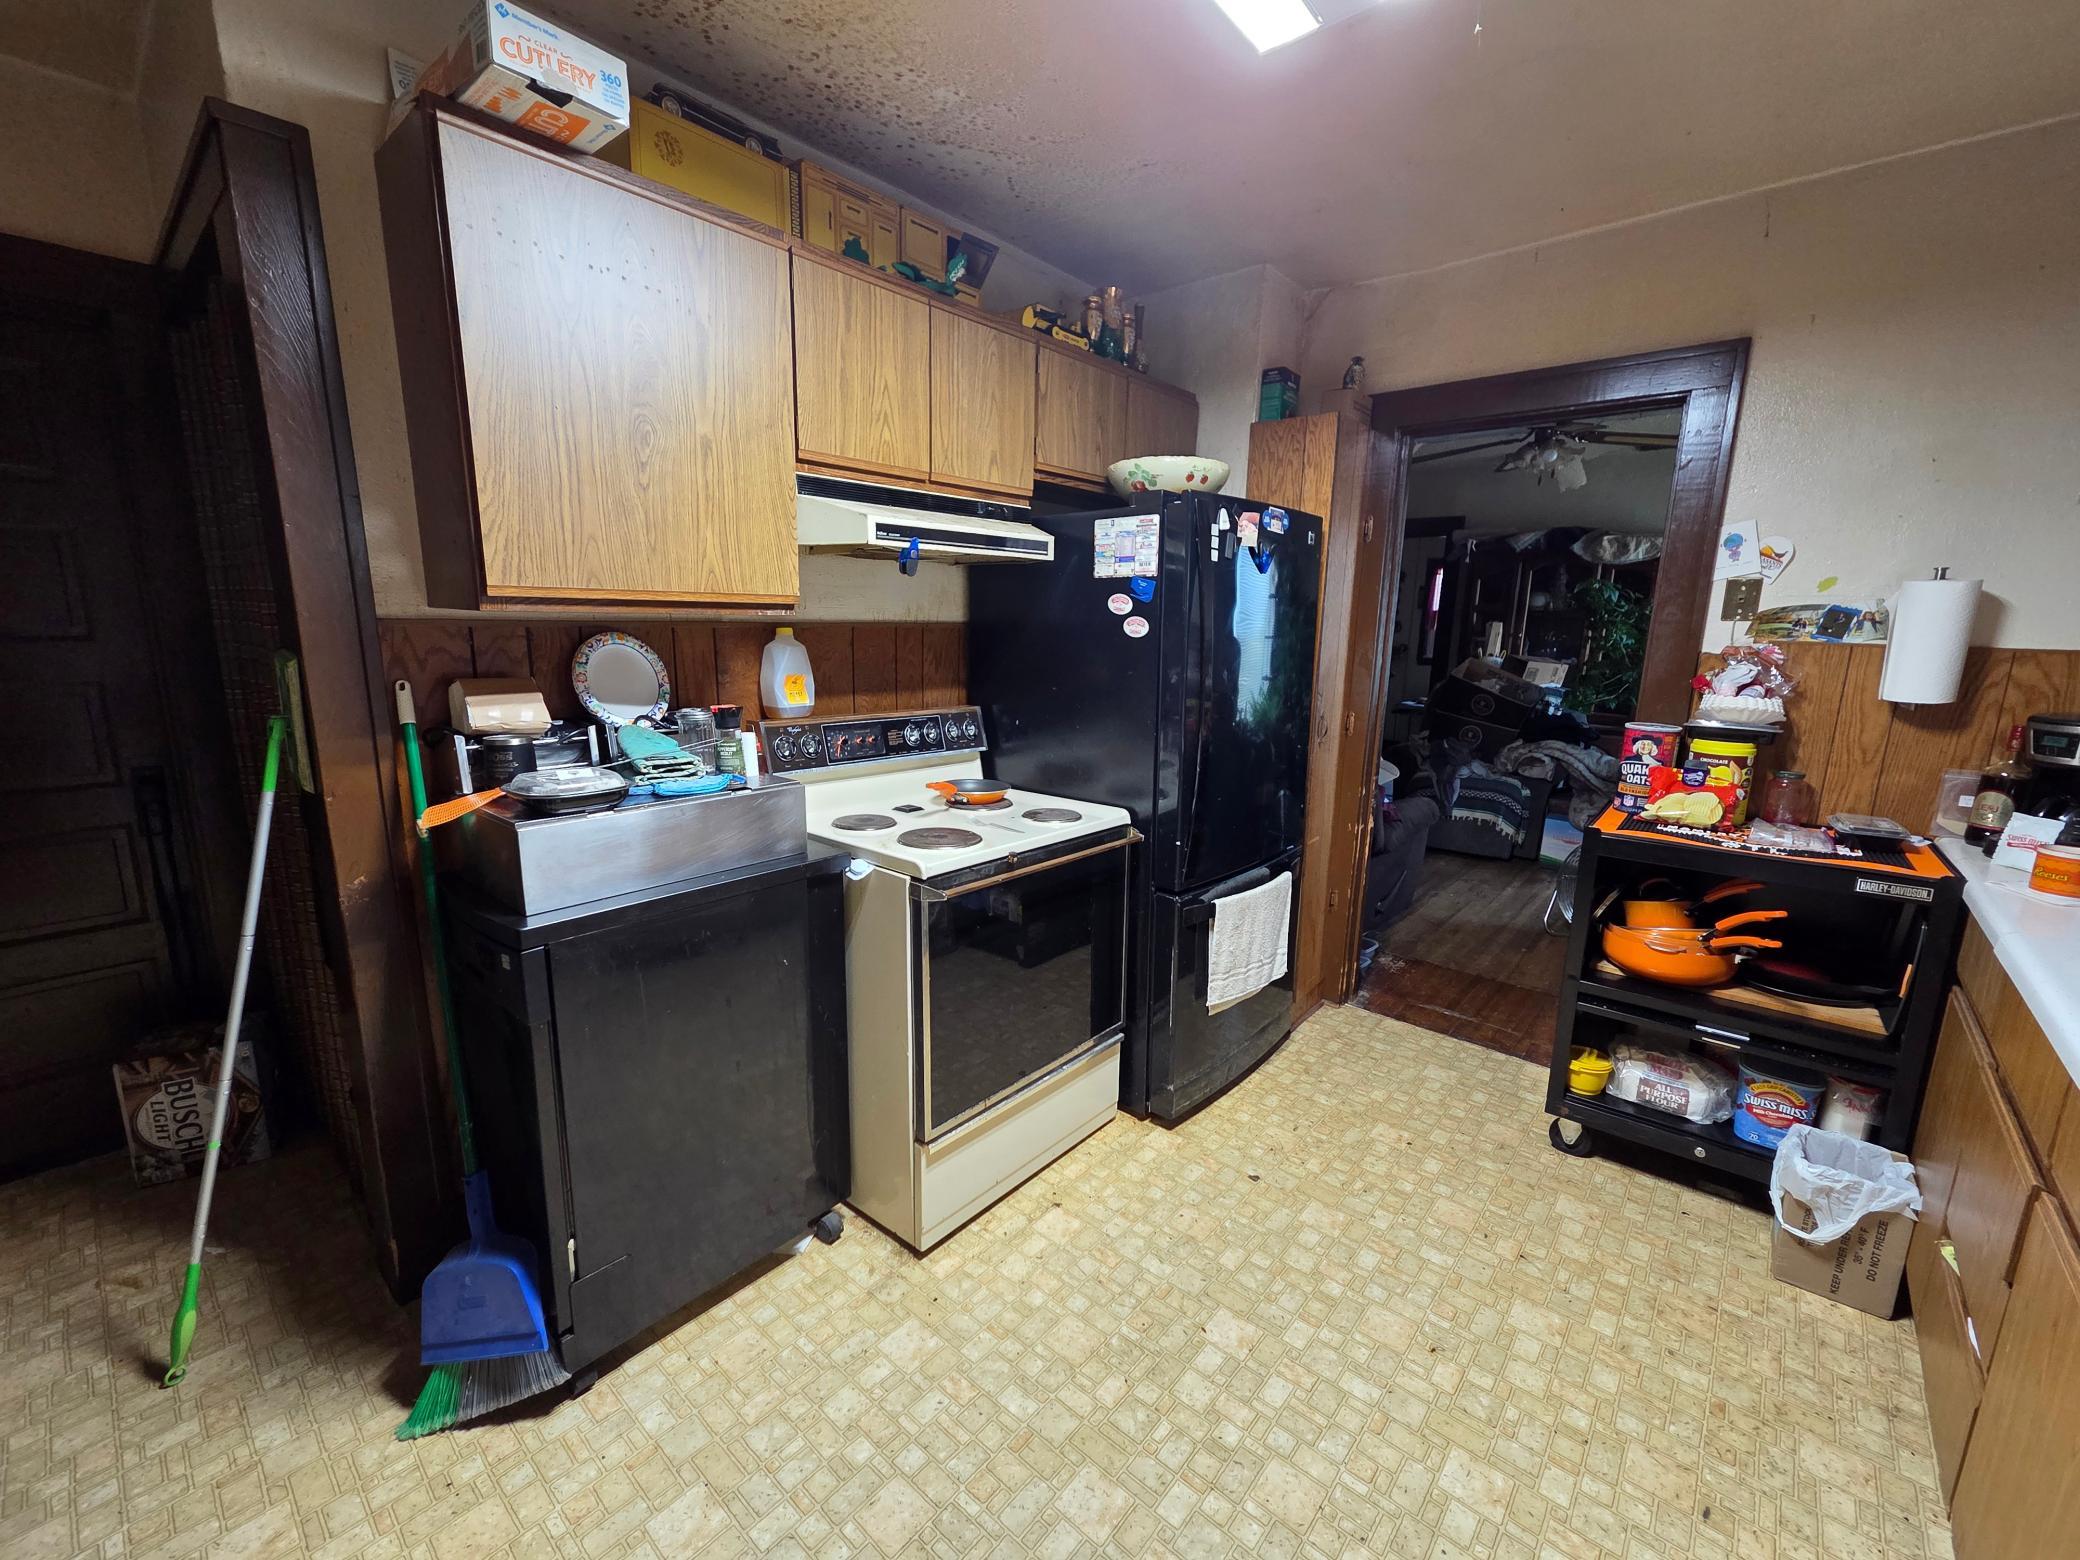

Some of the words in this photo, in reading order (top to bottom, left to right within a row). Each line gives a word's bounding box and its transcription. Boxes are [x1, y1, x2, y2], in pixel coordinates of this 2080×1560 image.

[499, 36, 597, 90] CUTLERY
[599, 69, 622, 88] 360
[1640, 1085, 1688, 1105] PURPOSE
[1654, 1083, 1672, 1094] ALL
[1645, 1094, 1679, 1109] FLOUR
[1743, 1093, 1778, 1110] SWISS
[1779, 1105, 1809, 1120] MISS
[150, 1101, 171, 1142] LIGHT
[163, 1077, 207, 1162] BUSCH
[1765, 1110, 1793, 1119] Chocolate
[1874, 1219, 1890, 1252] FREEZE
[1834, 1247, 1848, 1274] UNDER
[1869, 1251, 1882, 1269] NOT
[1830, 1275, 1841, 1294] KEEP
[1866, 1269, 1877, 1282] DO
